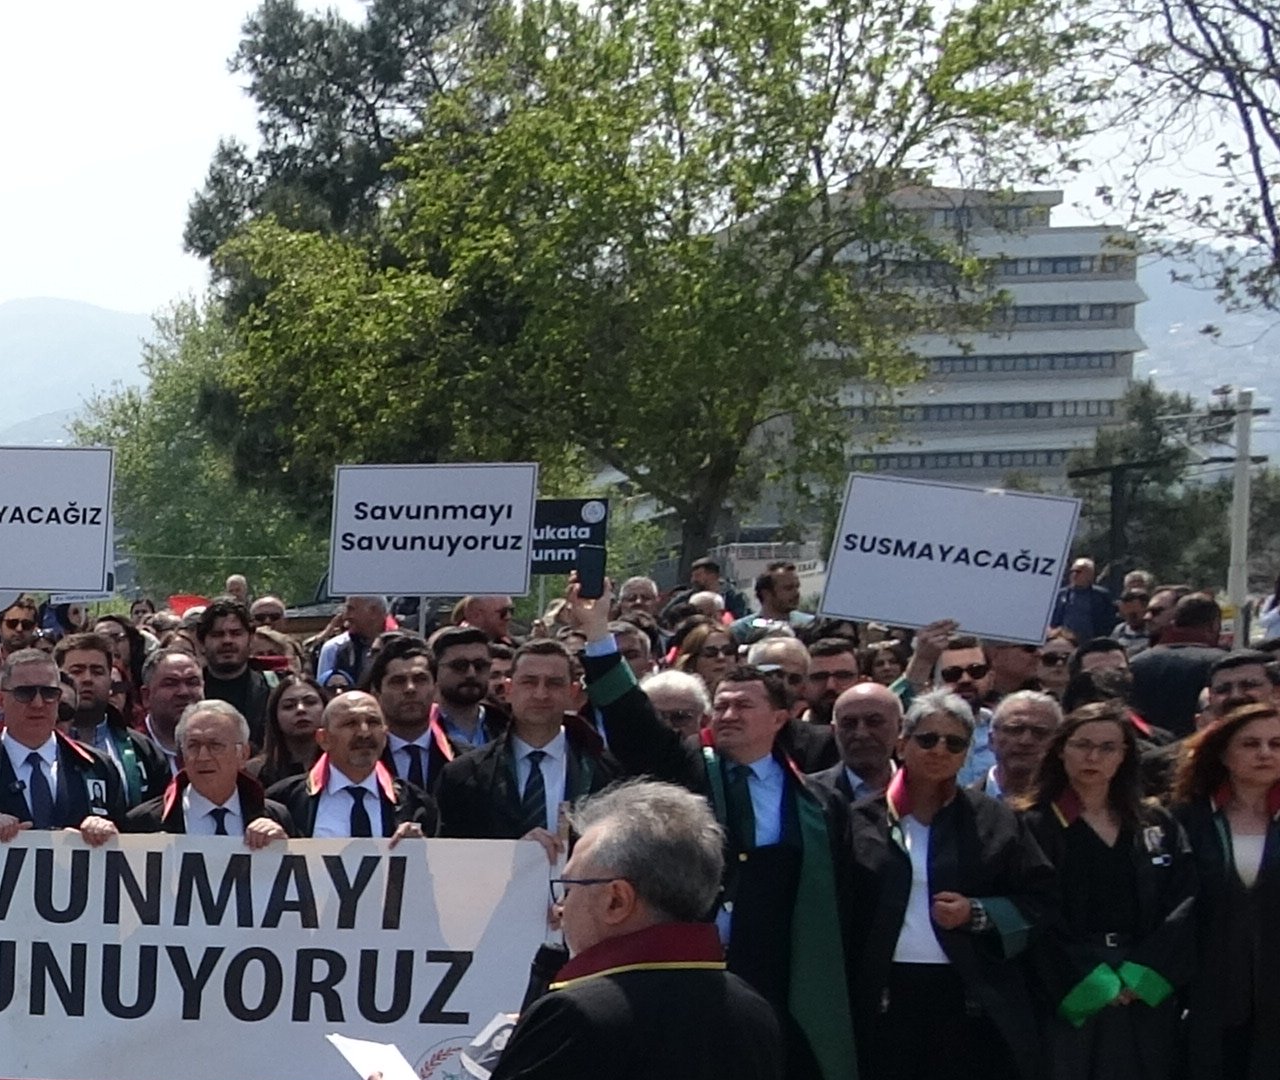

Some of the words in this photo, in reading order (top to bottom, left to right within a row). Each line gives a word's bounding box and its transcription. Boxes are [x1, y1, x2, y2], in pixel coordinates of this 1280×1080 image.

[354, 502, 513, 526] Savunmayı
[341, 532, 523, 557] Savunuyoruz
[533, 525, 591, 540] ukata
[843, 533, 1056, 577] SUSMAYACAĞIZ
